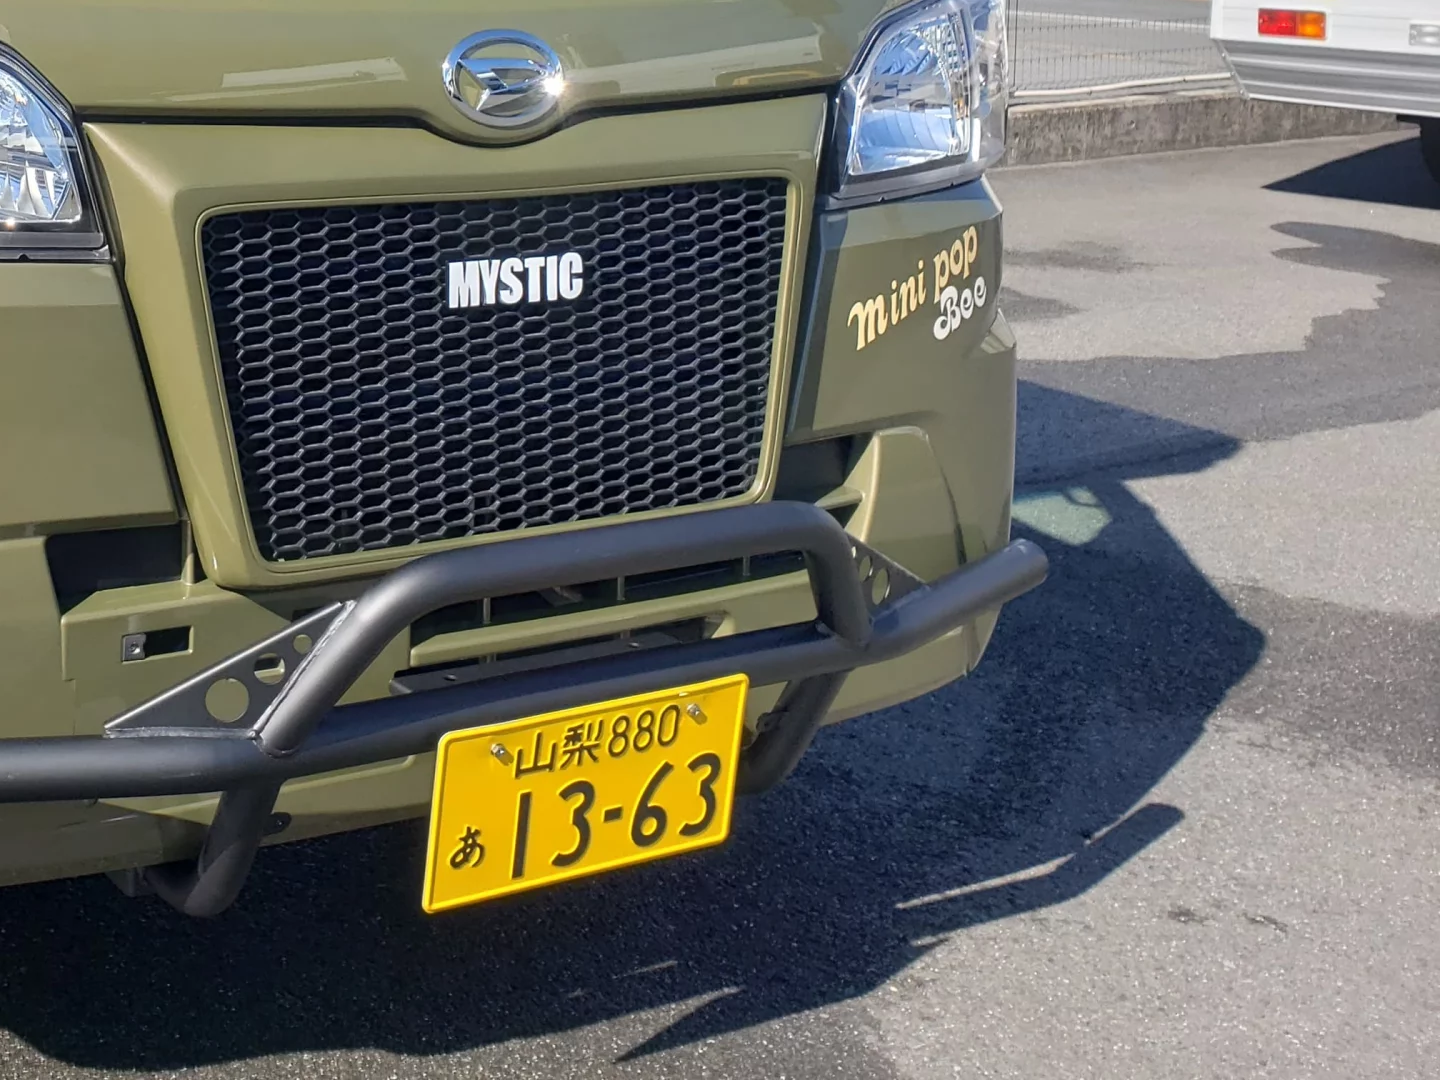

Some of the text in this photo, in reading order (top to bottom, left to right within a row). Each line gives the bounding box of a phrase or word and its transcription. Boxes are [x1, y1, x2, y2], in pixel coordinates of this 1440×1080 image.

[448, 251, 584, 309] MYSTIC
[933, 225, 978, 305] pop
[933, 276, 987, 341] Bee
[448, 751, 722, 881] あ 13-63
